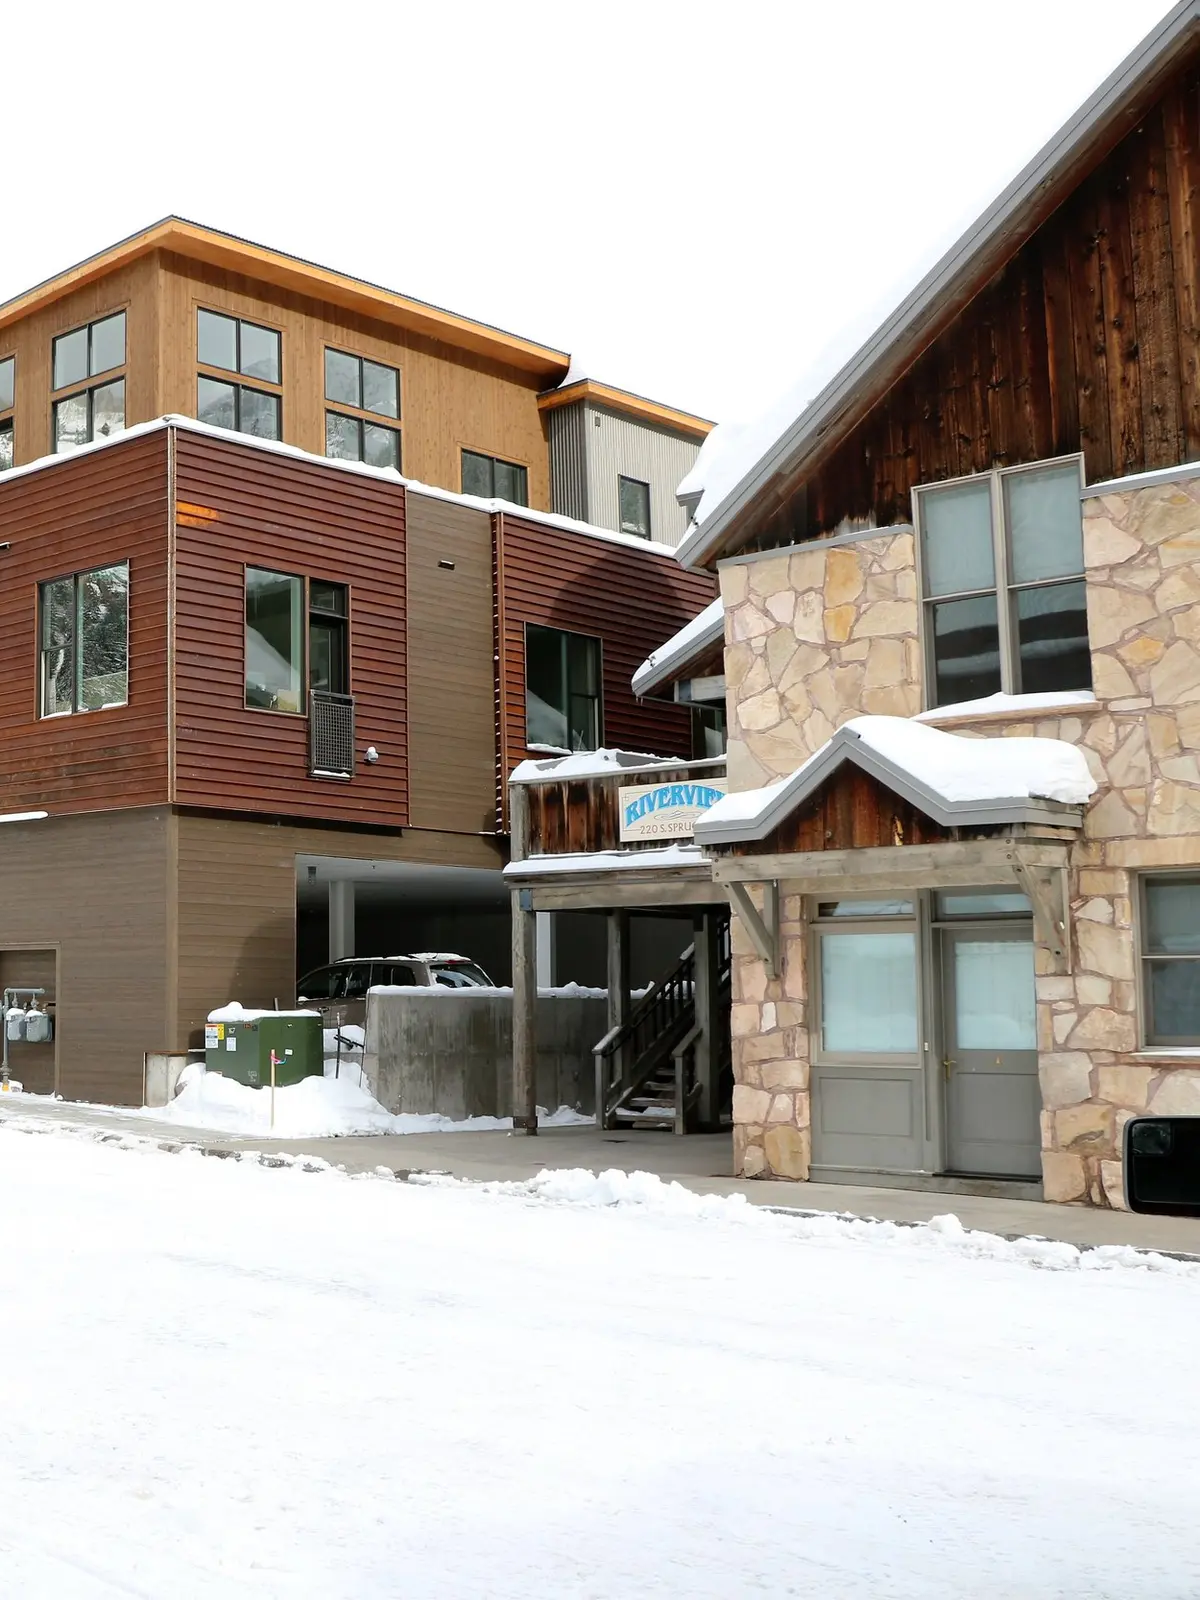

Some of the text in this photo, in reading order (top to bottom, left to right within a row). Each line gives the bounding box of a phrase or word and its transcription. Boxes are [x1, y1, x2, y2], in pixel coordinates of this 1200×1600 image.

[640, 820, 695, 834] 220 S. SPRU
